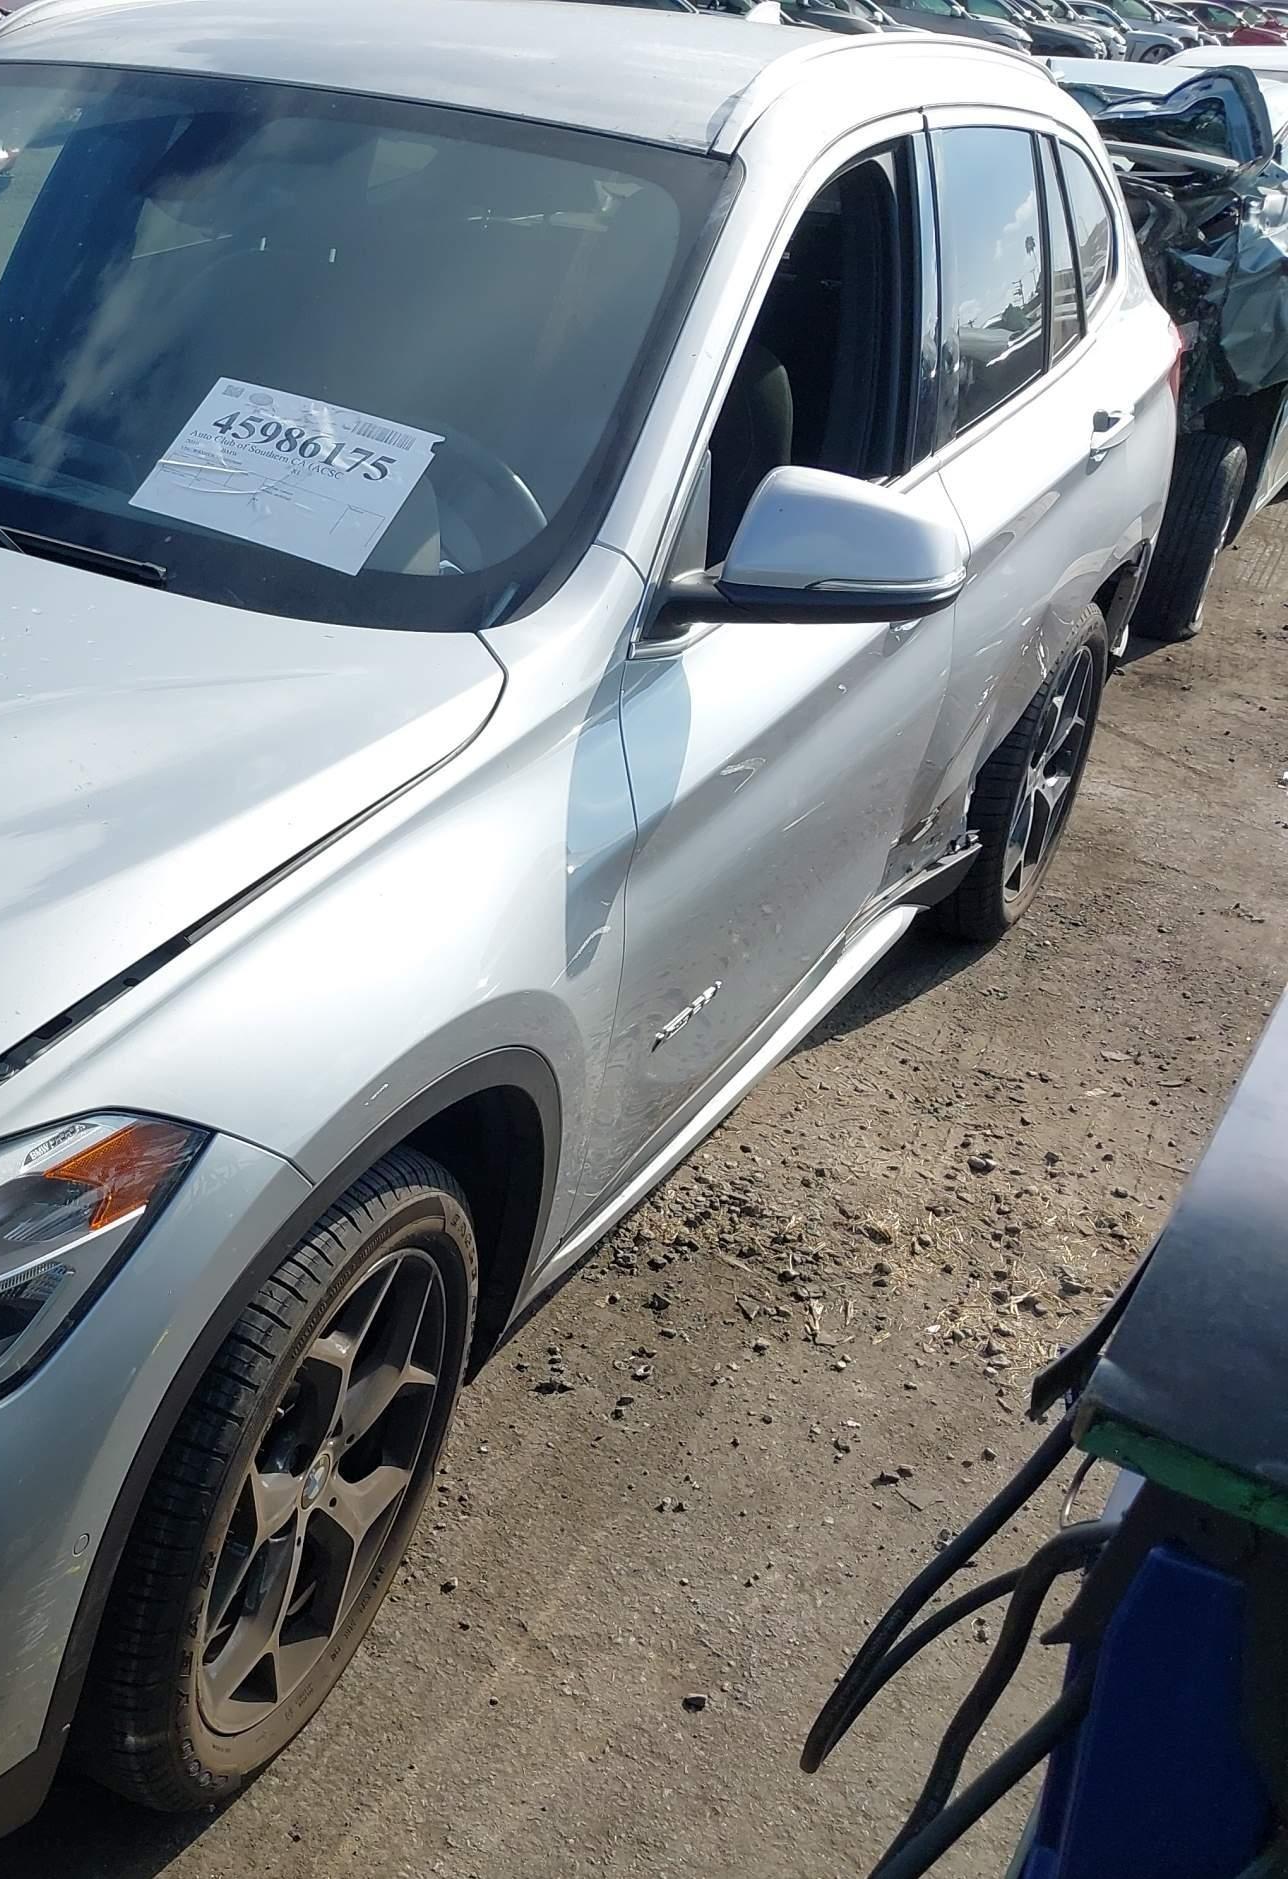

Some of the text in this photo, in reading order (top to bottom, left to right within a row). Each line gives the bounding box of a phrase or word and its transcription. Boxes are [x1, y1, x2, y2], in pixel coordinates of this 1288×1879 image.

[190, 430, 212, 440] Auto
[214, 435, 235, 447] Club
[237, 442, 250, 450] of
[248, 445, 289, 463] Southern
[291, 457, 306, 467] CA
[213, 411, 397, 481] 45986175
